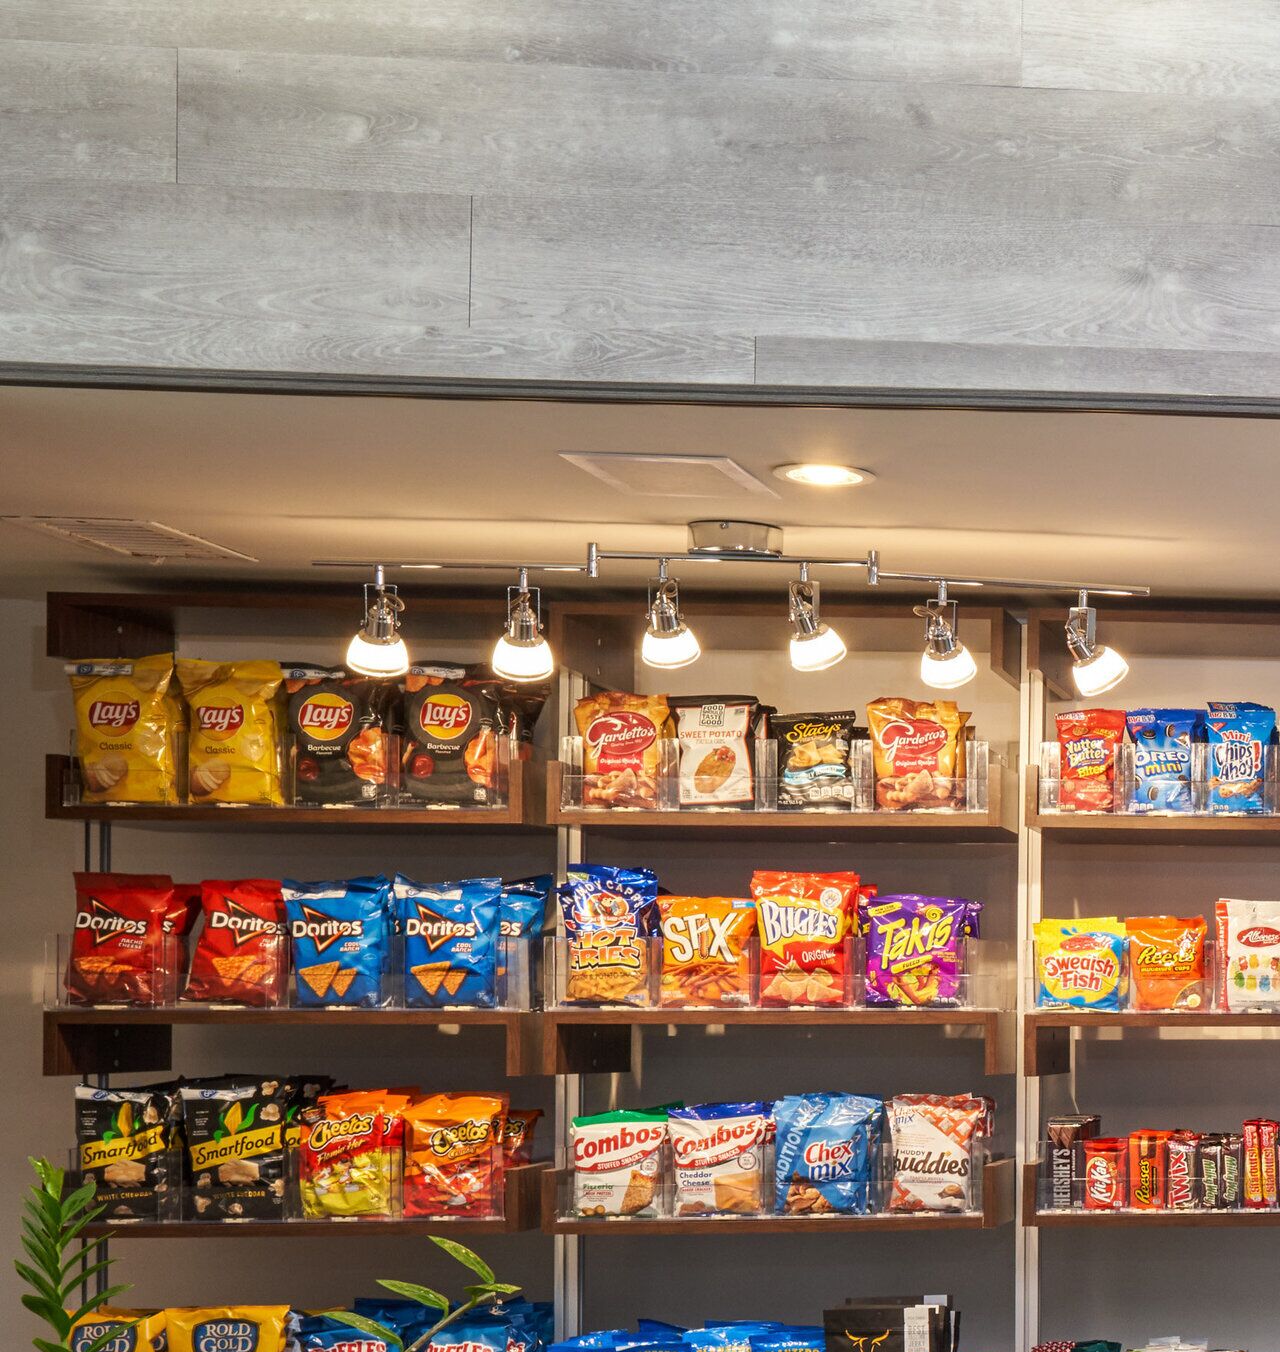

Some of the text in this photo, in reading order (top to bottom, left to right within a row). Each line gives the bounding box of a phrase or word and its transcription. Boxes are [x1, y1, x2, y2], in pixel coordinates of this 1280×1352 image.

[92, 700, 140, 725] Lay's
[302, 701, 353, 726] Lay's
[424, 701, 471, 726] Lay's
[586, 717, 657, 758] Gardetto's
[680, 730, 742, 739] SWEET POTATO
[786, 722, 841, 743] Stacy's
[879, 723, 948, 760] Gardetto's
[99, 741, 133, 751] Classic
[307, 743, 341, 752] Barbecue
[1135, 750, 1189, 766] OREO
[76, 912, 146, 935] Doritos
[292, 920, 362, 938] Doritos
[406, 919, 476, 938] Doritos
[761, 901, 839, 945] BUGLES
[879, 912, 954, 966] Takis
[569, 947, 640, 969] FRIES
[1061, 972, 1103, 991] Fish
[309, 1114, 375, 1150] Cheetos
[573, 1126, 663, 1159] Combos
[674, 1122, 756, 1156] Combos
[81, 1130, 164, 1162] Smartfood
[196, 1134, 276, 1164] Smartfood
[805, 1141, 853, 1165] Chex
[899, 1149, 926, 1157] MUDDY
[893, 1150, 969, 1176] buddies
[679, 1172, 712, 1180] Cheddar
[682, 1179, 709, 1187] Cheese
[206, 1322, 251, 1340] ROLD
